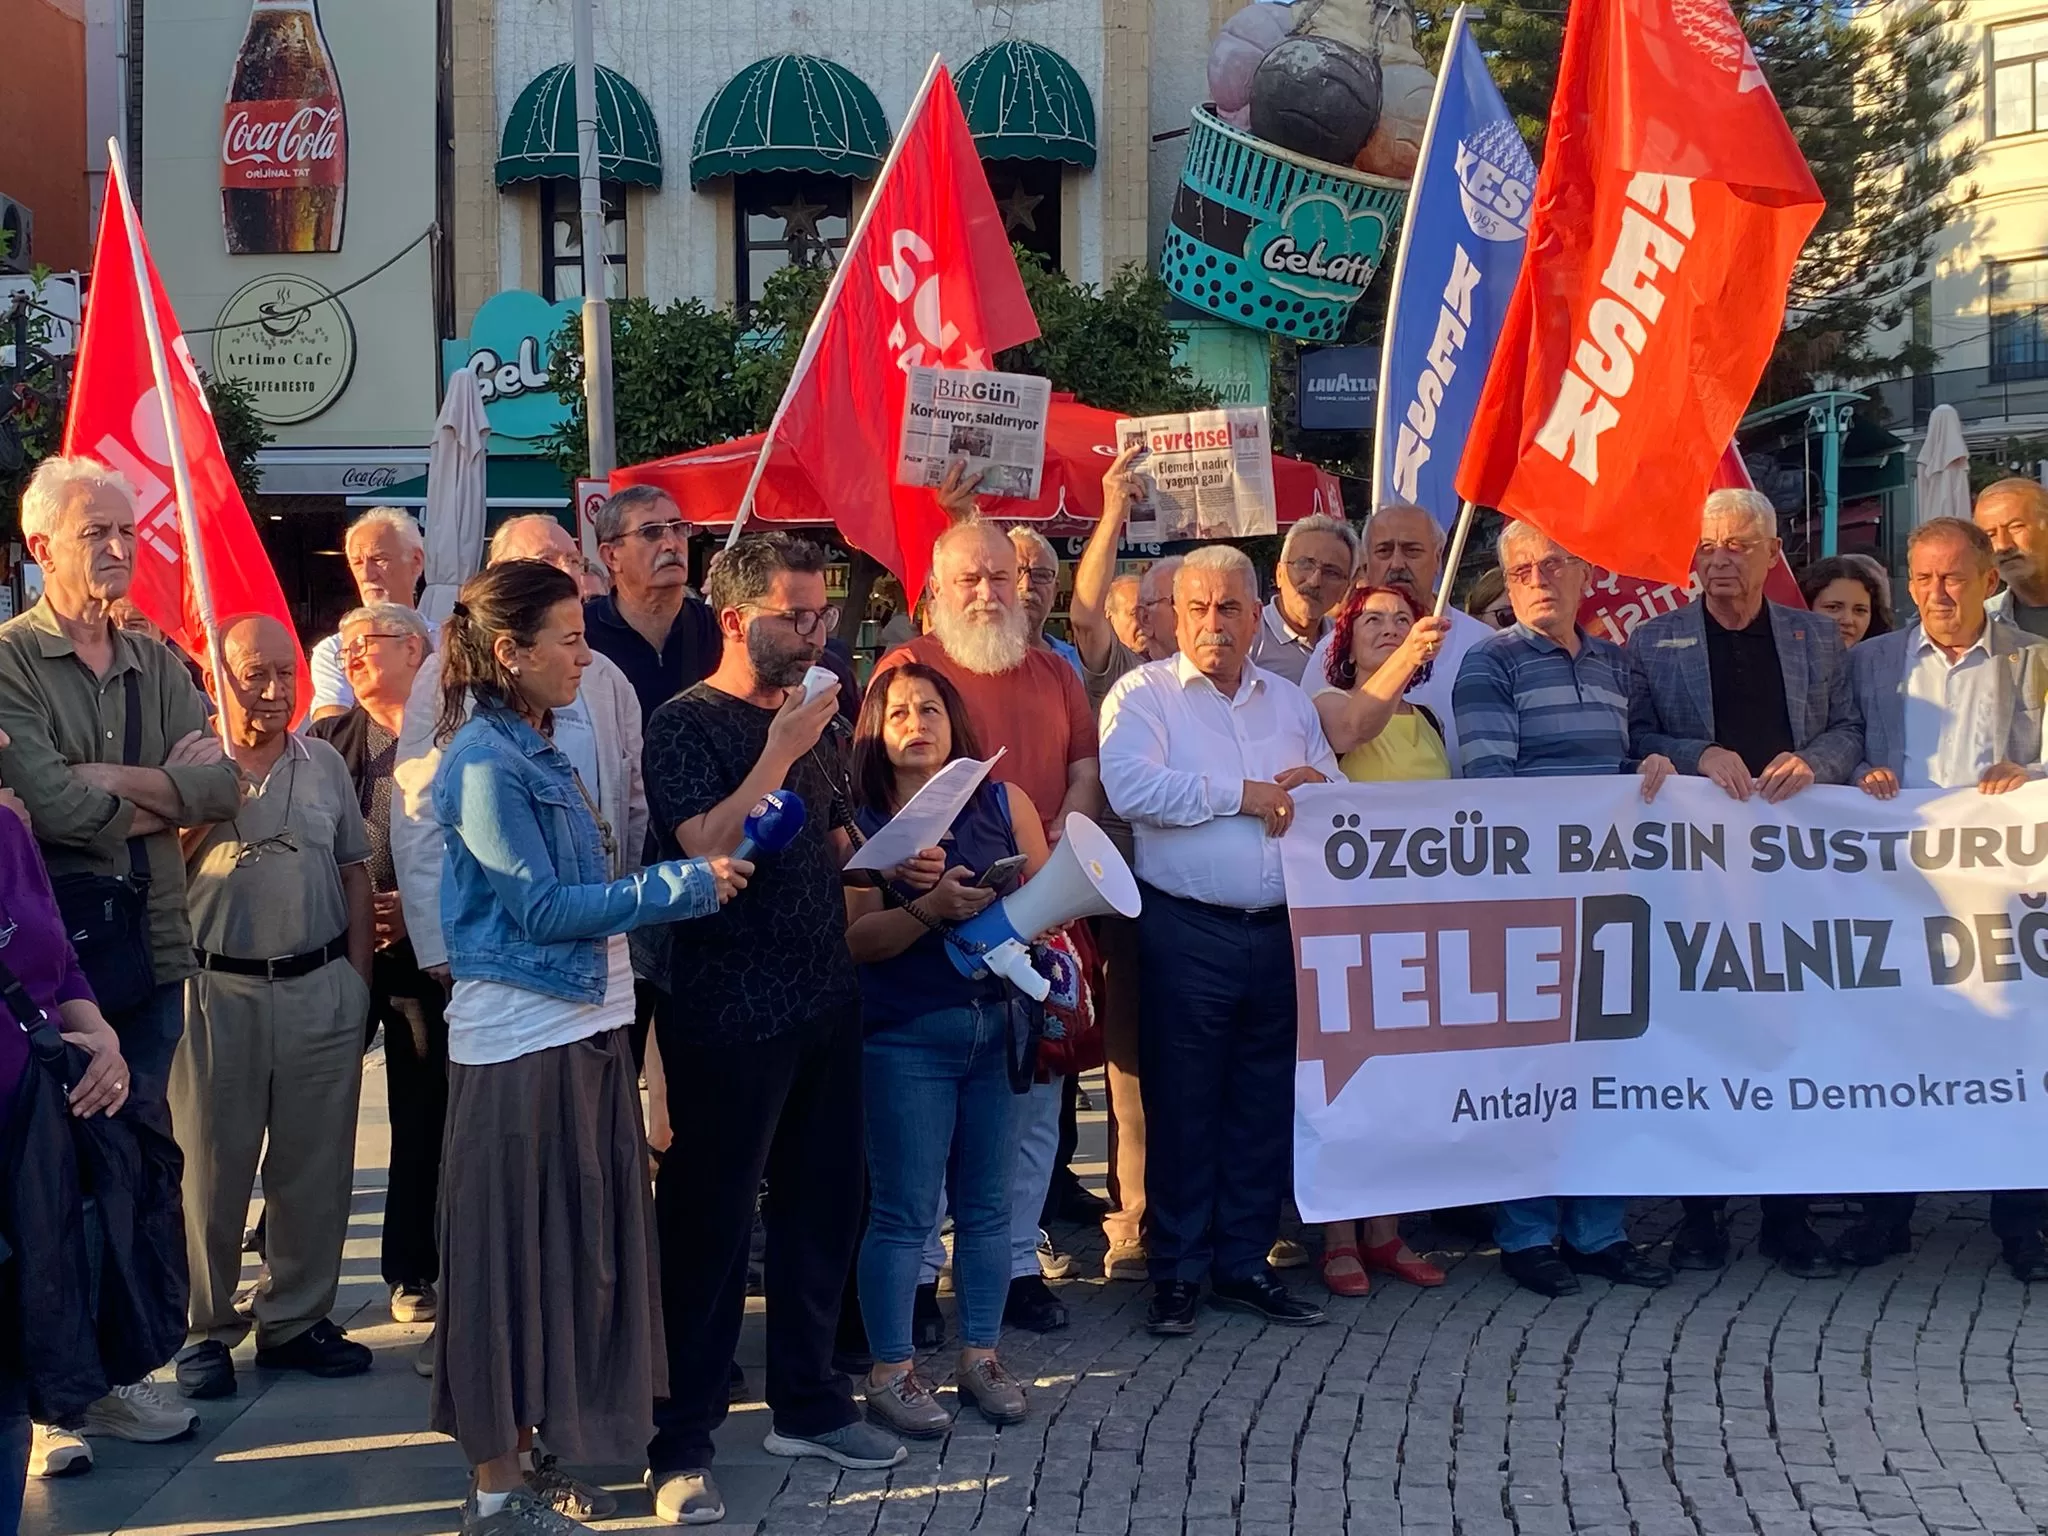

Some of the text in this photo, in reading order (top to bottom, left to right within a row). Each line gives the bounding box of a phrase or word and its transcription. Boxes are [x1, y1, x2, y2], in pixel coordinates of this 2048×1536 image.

[223, 107, 340, 165] Coca-Cola
[293, 168, 310, 178] TAT
[1454, 139, 1533, 230] KES
[1468, 206, 1500, 235] 1995
[228, 353, 332, 366] Artimo Cafe
[247, 381, 316, 393] CAFE&RESTO
[1307, 373, 1378, 392] LAVAZZA
[910, 402, 1039, 431] Korkuyor, saldırıyor
[1152, 421, 1232, 453] evrensel
[342, 467, 398, 488] Coca-Cola
[1158, 460, 1200, 474] Element
[1201, 471, 1223, 487] gani
[1324, 810, 1532, 881] ÖZGÜR
[1558, 821, 1726, 874] BASIN
[1663, 918, 1901, 993] YALNIZ
[1451, 1082, 1578, 1124] Antalya
[1592, 1076, 1711, 1112] Emek
[1720, 1077, 1774, 1111] Ve
[1788, 1067, 2027, 1111] Demokrasi
